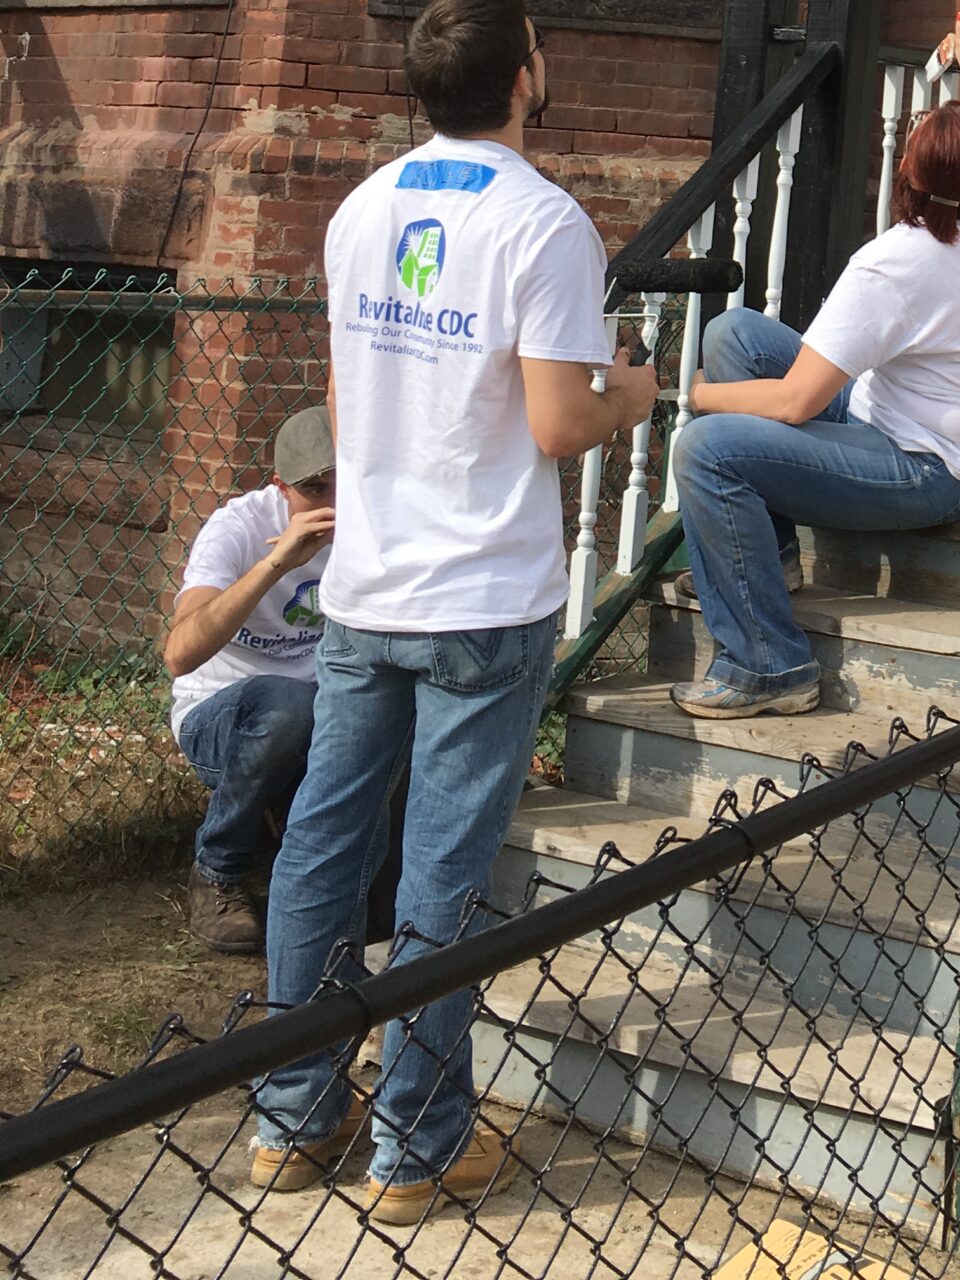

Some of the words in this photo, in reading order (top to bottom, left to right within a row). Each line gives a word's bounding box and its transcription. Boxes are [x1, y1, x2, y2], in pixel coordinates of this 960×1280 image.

[345, 322, 379, 337] Rebuing
[381, 326, 401, 338] Our
[404, 329, 435, 348] Cmmuny
[437, 340, 459, 352] Since
[463, 342, 484, 354] 1992
[437, 309, 478, 338] CDC
[370, 340, 439, 365] RevitalizDC.om
